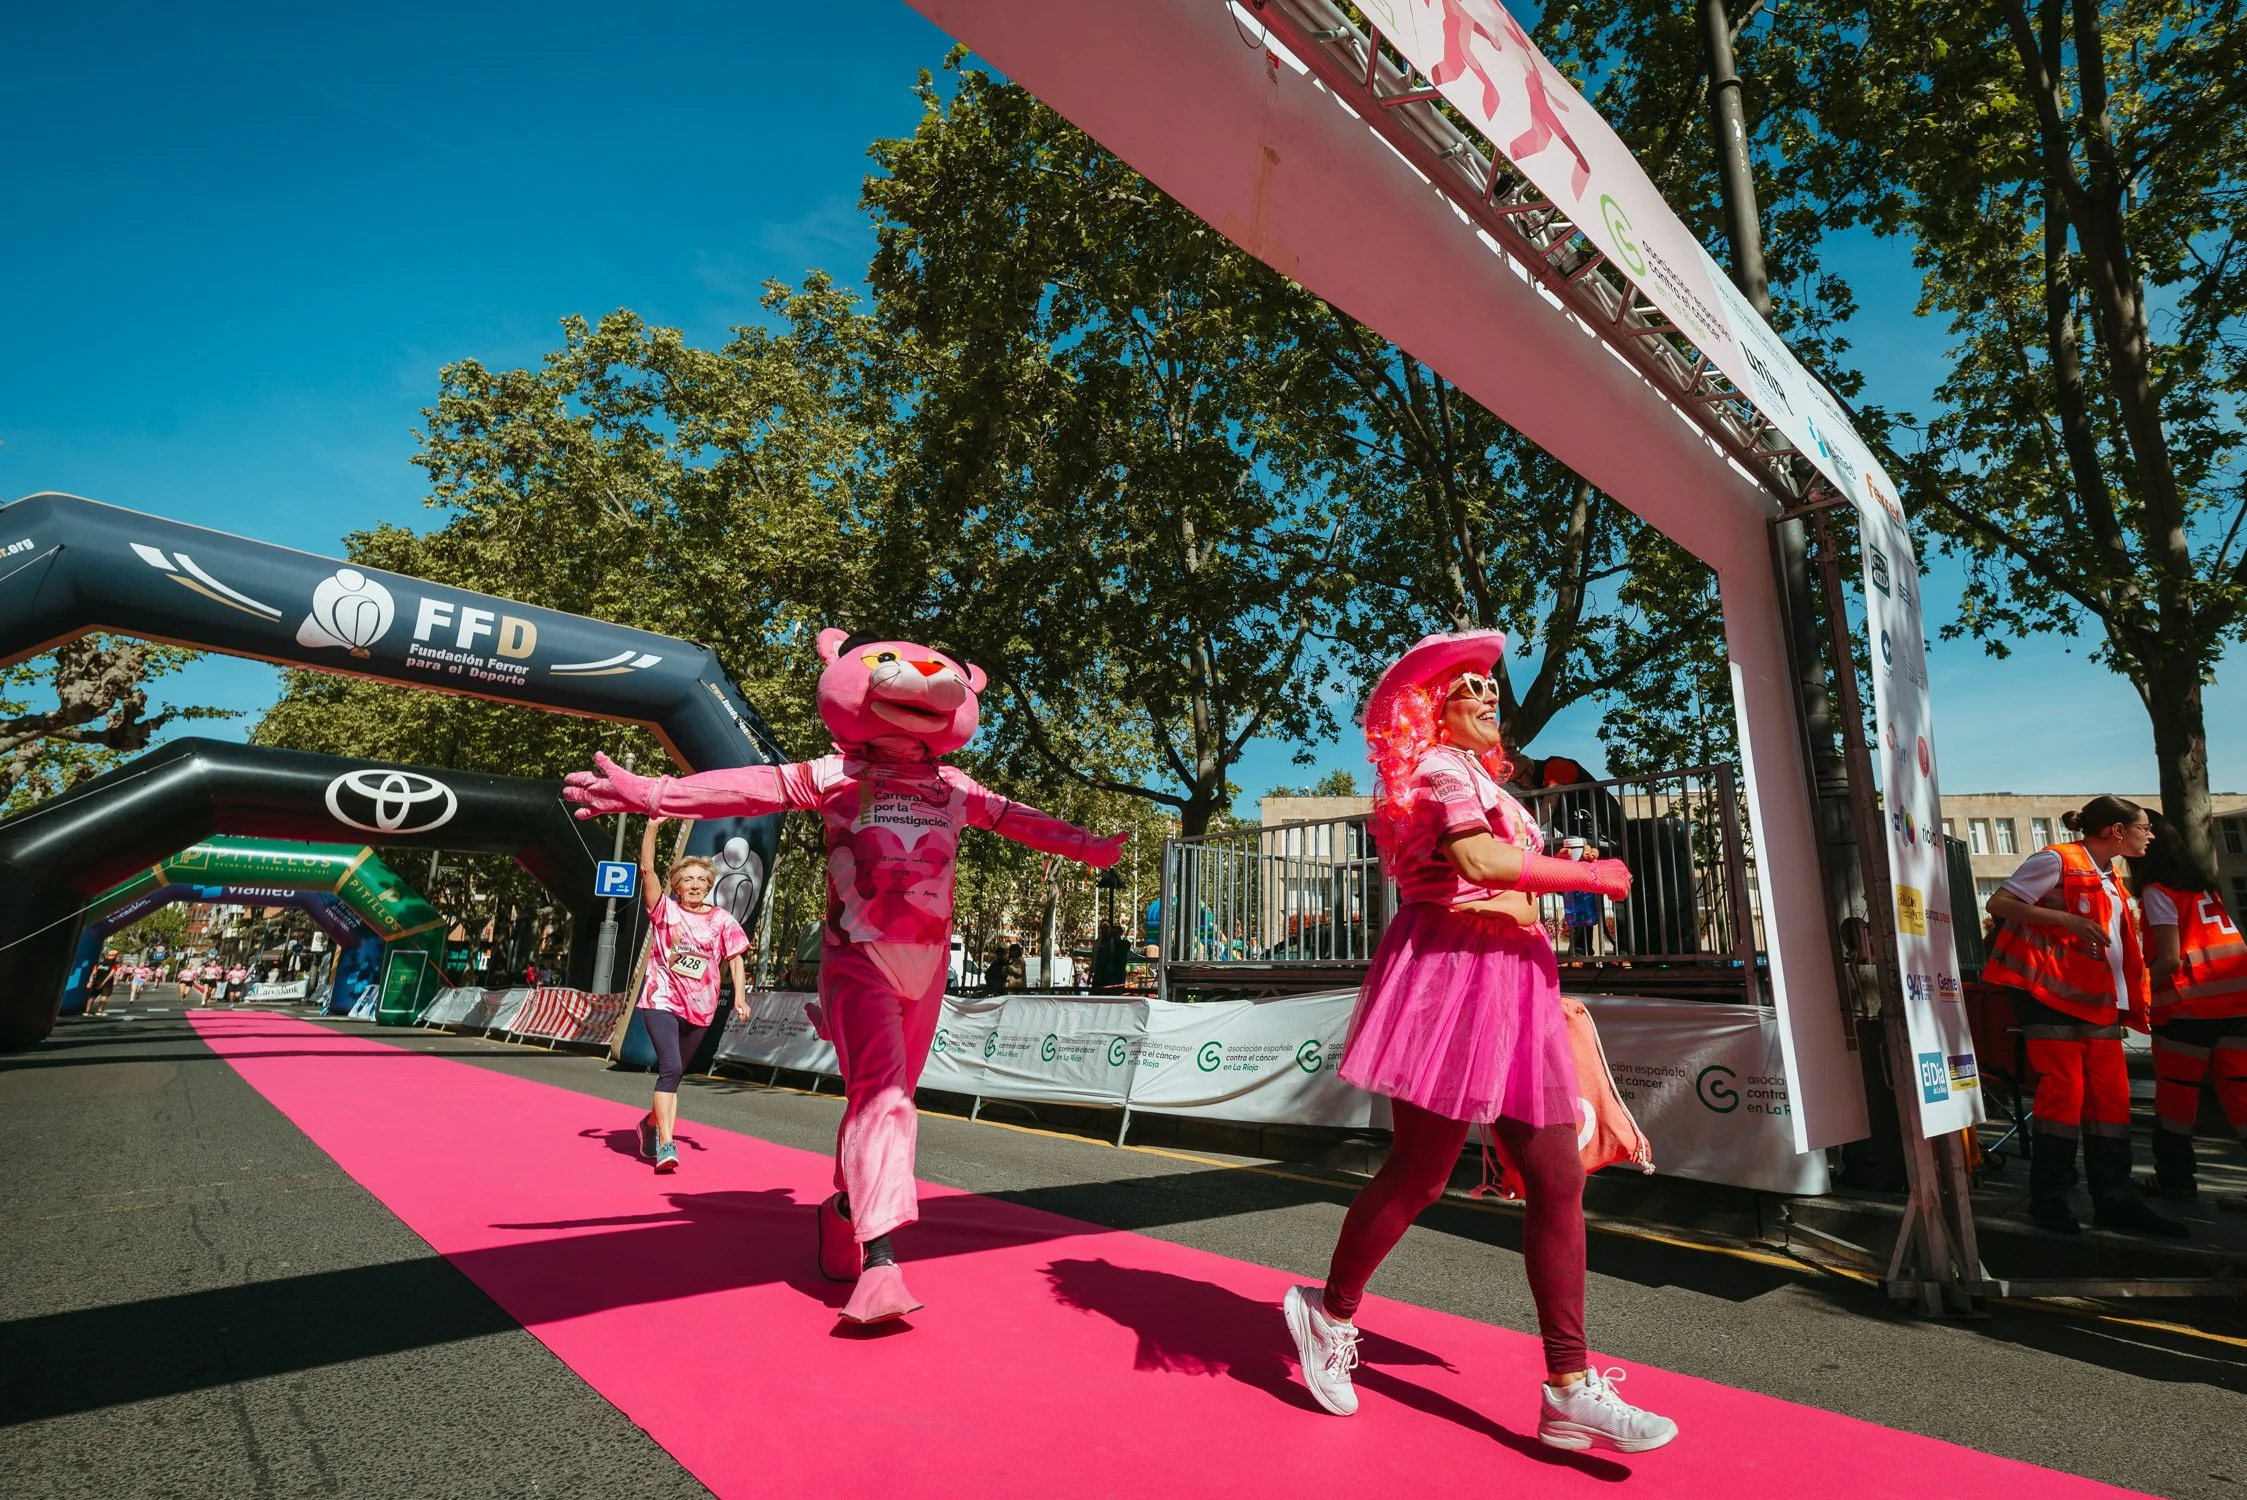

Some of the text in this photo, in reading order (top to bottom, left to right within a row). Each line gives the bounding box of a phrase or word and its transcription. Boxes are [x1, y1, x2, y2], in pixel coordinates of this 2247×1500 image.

[413, 597, 538, 660] FFD
[409, 643, 530, 675] Fundación Ferrer
[406, 657, 526, 686] para el Deporte
[874, 791, 920, 802] Carrera
[874, 803, 909, 814] por la
[874, 814, 949, 829] Investigación
[603, 865, 629, 893] P
[349, 880, 399, 931] PITILLOS
[674, 953, 701, 970] 2428
[1227, 1043, 1293, 1053] asociación española
[1147, 1050, 1155, 1058] el
[1155, 1052, 1181, 1061] cáncer
[1226, 1053, 1279, 1062] contra el cáncer
[1142, 1059, 1160, 1068] Rioja
[1223, 1063, 1259, 1073] en La Rioja
[1325, 1063, 1335, 1071] en
[1635, 1066, 1685, 1077] española
[1625, 1077, 1663, 1088] cáncer
[1747, 1075, 1785, 1086] asocia
[1747, 1089, 1787, 1100] contra
[1747, 1104, 1763, 1114] en
[1765, 1103, 1782, 1115] La
